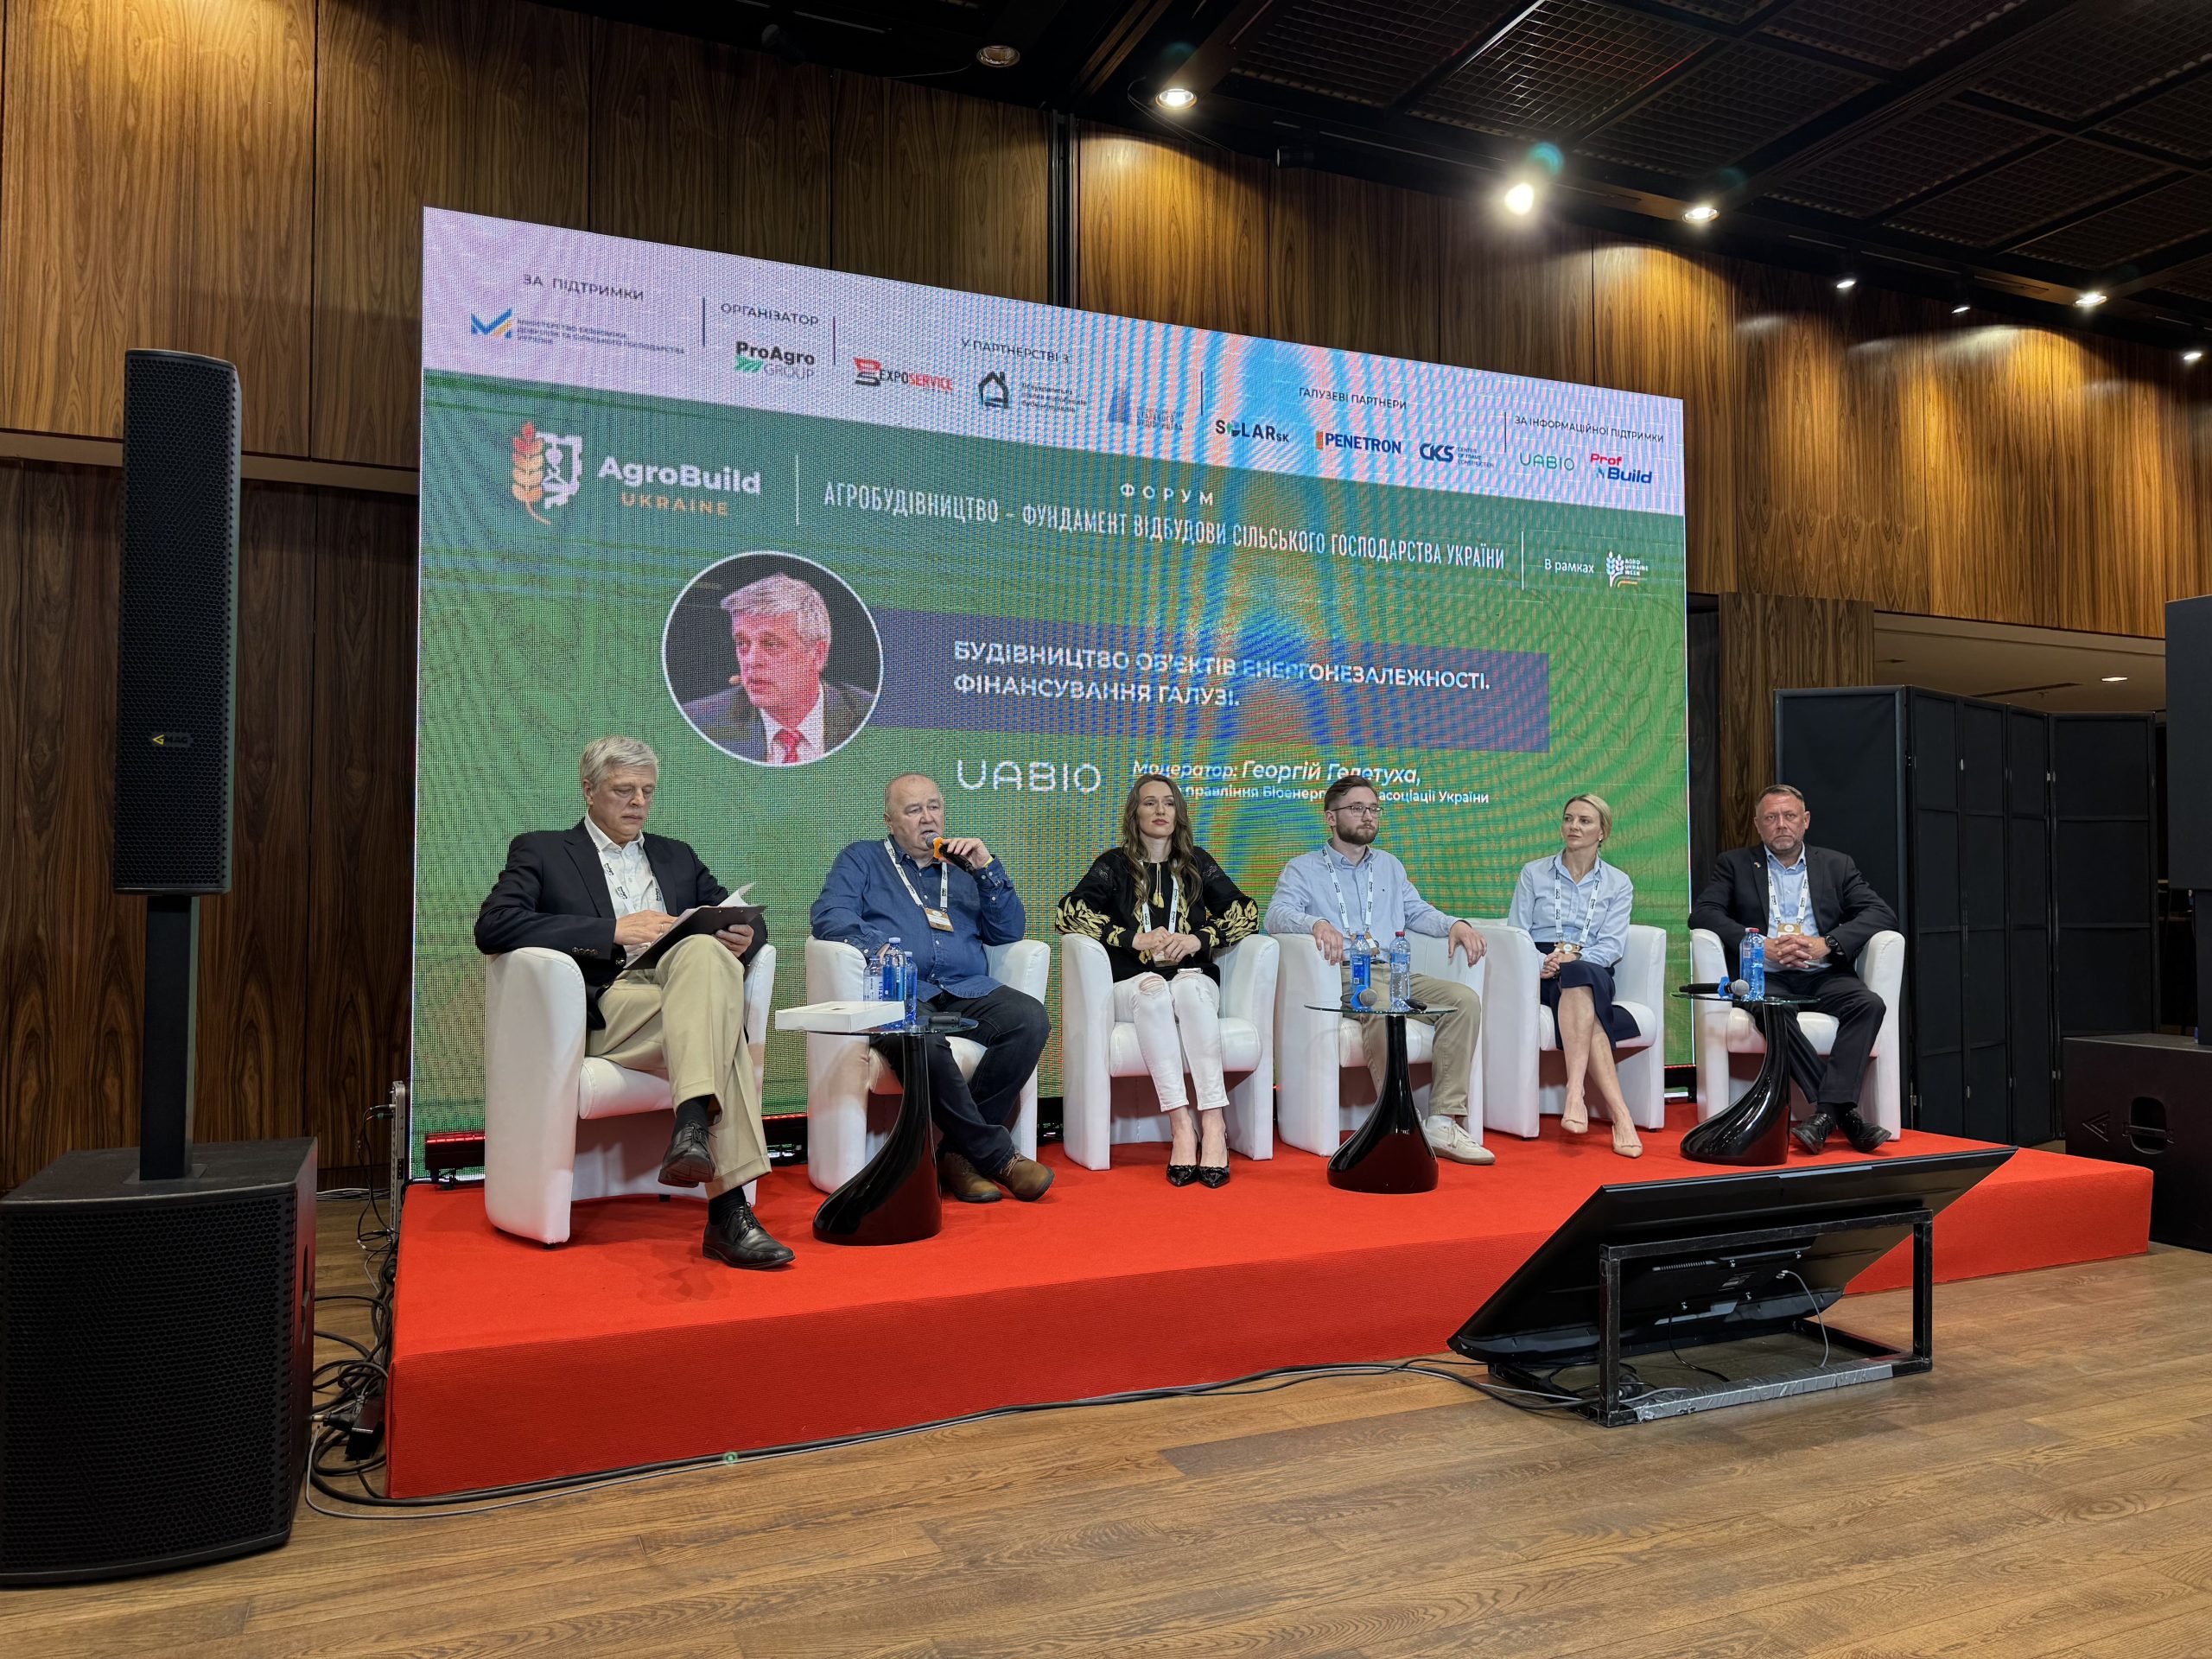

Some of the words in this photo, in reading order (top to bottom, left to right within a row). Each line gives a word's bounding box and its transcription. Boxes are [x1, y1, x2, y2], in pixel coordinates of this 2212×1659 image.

[523, 274, 543, 287] ЗА
[553, 277, 644, 301] ПІДТРИМКИ
[721, 302, 819, 326] ОРГАНІЗАТОР
[735, 340, 815, 365] ProAgro
[961, 339, 969, 349] У
[974, 340, 1059, 362] ПАРТНЕРСТВІ
[764, 363, 815, 380] GROUP
[1299, 387, 1349, 403] ГАЛУЗЕВІ
[1351, 394, 1407, 410] ПАРТНЕРИ
[1515, 416, 1528, 425] ЗА
[1529, 417, 1609, 436] ІНФОРМАЦІЙНОЇ
[1611, 426, 1664, 443] ПІДТРИМКИ
[1325, 433, 1402, 454] PENETRON
[1419, 443, 1455, 463] CKS
[1519, 452, 1575, 472] UABIO
[1590, 453, 1622, 467] Prof
[597, 454, 762, 496] AgroBuild
[1606, 467, 1652, 484] Build
[621, 492, 728, 517] UKRAINE
[1120, 482, 1214, 506] ФОРУМ
[824, 481, 999, 524] АГРОБУДІВНИЦТВО
[1022, 503, 1127, 536] ФУНДАМЕНТ
[1134, 514, 1226, 545] ВІДБУДОВИ
[1232, 524, 1325, 554] СІЛЬСЬКОГО
[1331, 533, 1442, 564] ГОСПОДАРСТВА
[1446, 542, 1505, 569] УКРАЇНИ
[1545, 558, 1552, 570] В
[1554, 562, 1594, 574] рамках
[954, 640, 1130, 671] БУДІВНИЦТВО
[1243, 658, 1491, 690] ЕНЕРГОНЕЗАЛЕЖНОСТІ.
[953, 674, 1152, 703] ФІНАНСУВАННЯ
[1159, 684, 1241, 707] ГАЛУЗІ.
[957, 760, 1102, 792] UABIO
[1133, 760, 1237, 779] Модератор:
[1243, 760, 1321, 783] Георгій
[1185, 785, 1259, 799] правління
[1379, 788, 1435, 804] асоціації
[1439, 790, 1490, 805] України
